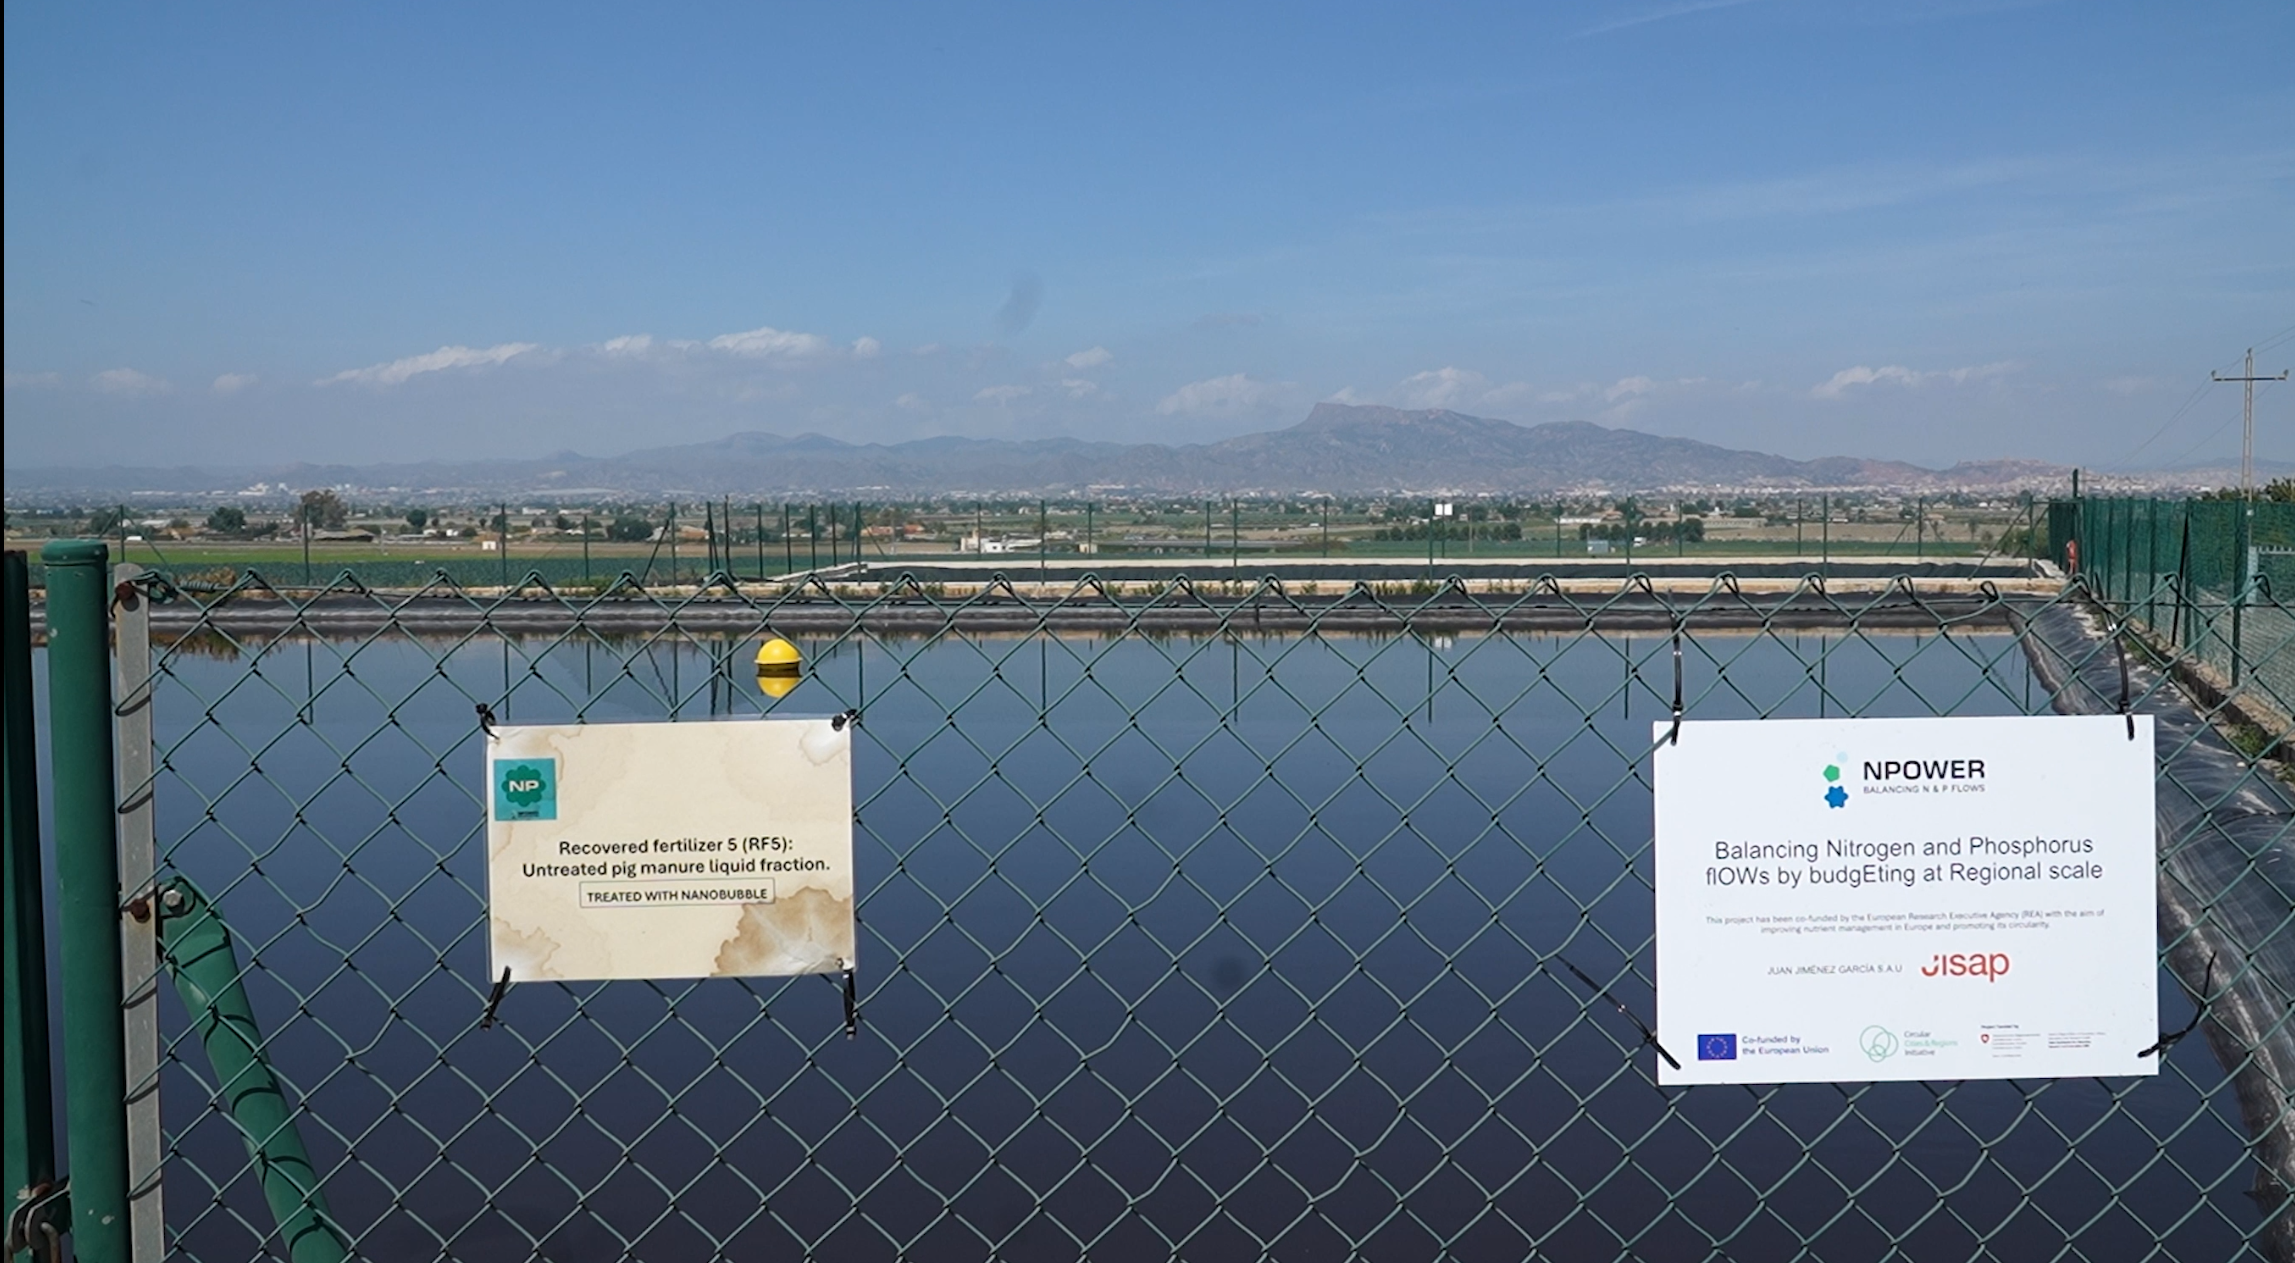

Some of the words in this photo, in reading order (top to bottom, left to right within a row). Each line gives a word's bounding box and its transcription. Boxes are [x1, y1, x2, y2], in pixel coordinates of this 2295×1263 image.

[1864, 759, 1985, 780] NPOWER
[509, 780, 539, 792] NP
[1864, 785, 1919, 794] BALANCING
[1923, 785, 1929, 793] N
[1933, 785, 1938, 793] &
[1951, 784, 1985, 792] FLOWS
[559, 839, 648, 856] Recovered
[652, 838, 723, 853] fertilizer
[727, 838, 738, 852] 5
[742, 837, 793, 853] (RF5):
[1714, 839, 1819, 863] Balancing
[1826, 838, 1916, 861] Nitrogen
[1923, 838, 1962, 857] and
[1969, 835, 2094, 858] Phosphorus
[522, 862, 608, 878] Untreated
[611, 862, 636, 879] pig
[641, 862, 705, 874] manure
[709, 859, 756, 875] liquid
[760, 857, 831, 872] fraction.
[1705, 866, 1770, 886] flOWs
[1778, 866, 1803, 888] by
[1809, 865, 1917, 887] budgEting
[1922, 864, 1944, 882] at
[1950, 861, 2042, 885] Regional
[2048, 860, 2104, 881] scale
[587, 891, 642, 903] TREATED
[646, 890, 678, 901] WITH
[682, 888, 768, 901] NANOBUBBLE
[1706, 916, 1722, 924] This
[1725, 916, 1753, 925] project
[1773, 915, 1793, 923] been
[1840, 914, 1849, 923] by
[1867, 914, 1905, 923] European
[1950, 911, 1987, 919] Executive
[1990, 911, 2019, 920] Agency
[2097, 909, 2104, 917] of
[1761, 926, 1801, 934] improving
[1838, 924, 1892, 933] management
[1905, 923, 1933, 931] Europe
[1953, 922, 1995, 931] promoting
[1767, 966, 1792, 975] JUAN
[1790, 1036, 1801, 1044] by
[1758, 1047, 1800, 1055] European
[1803, 1046, 1830, 1054] Union
